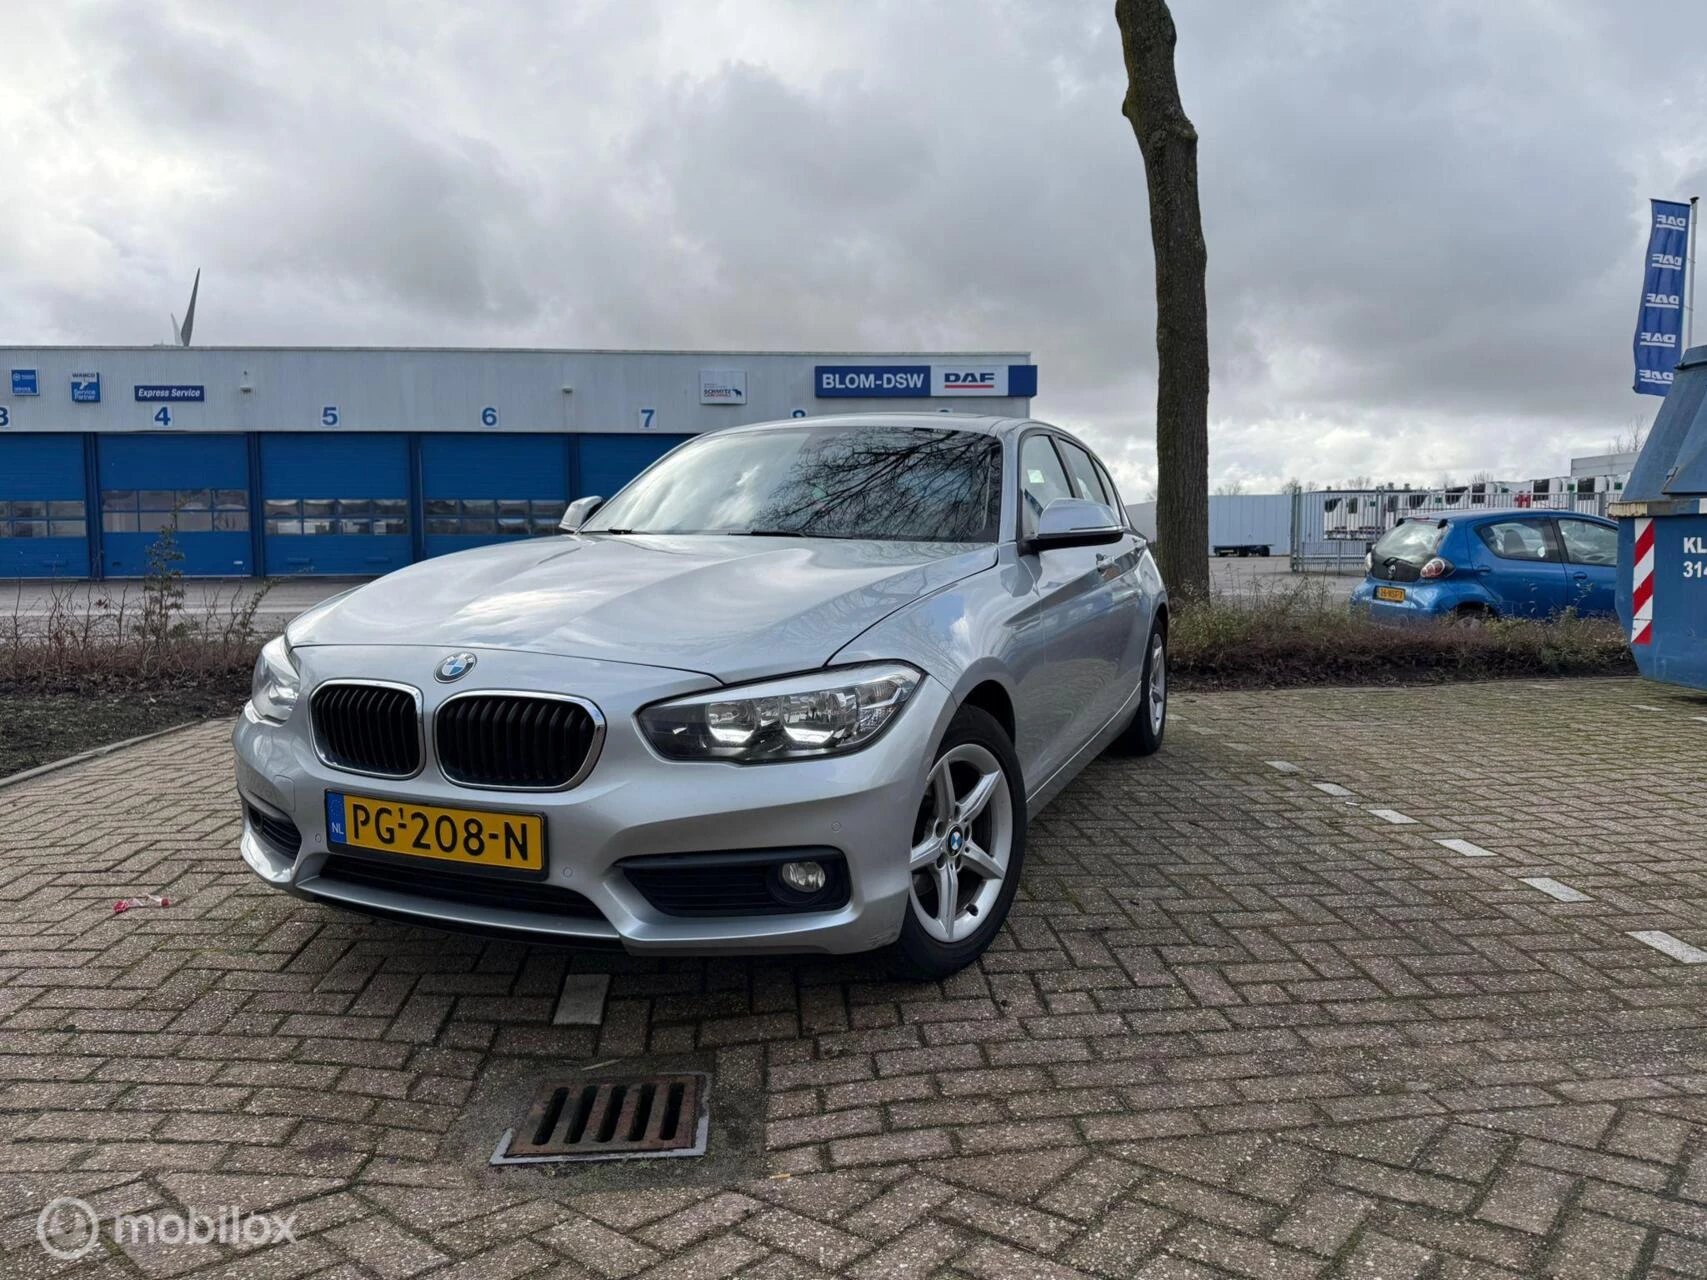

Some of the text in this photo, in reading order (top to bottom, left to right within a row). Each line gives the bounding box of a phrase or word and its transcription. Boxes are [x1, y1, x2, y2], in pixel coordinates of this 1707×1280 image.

[821, 373, 925, 389] BLOM-DSW
[944, 372, 995, 383] DAF
[138, 388, 201, 398] Express Service
[154, 406, 171, 426] 4
[321, 406, 338, 426] 5
[481, 407, 497, 426] 6
[640, 409, 655, 428] 7
[331, 821, 344, 835] NL
[352, 803, 529, 861] PG-208-N
